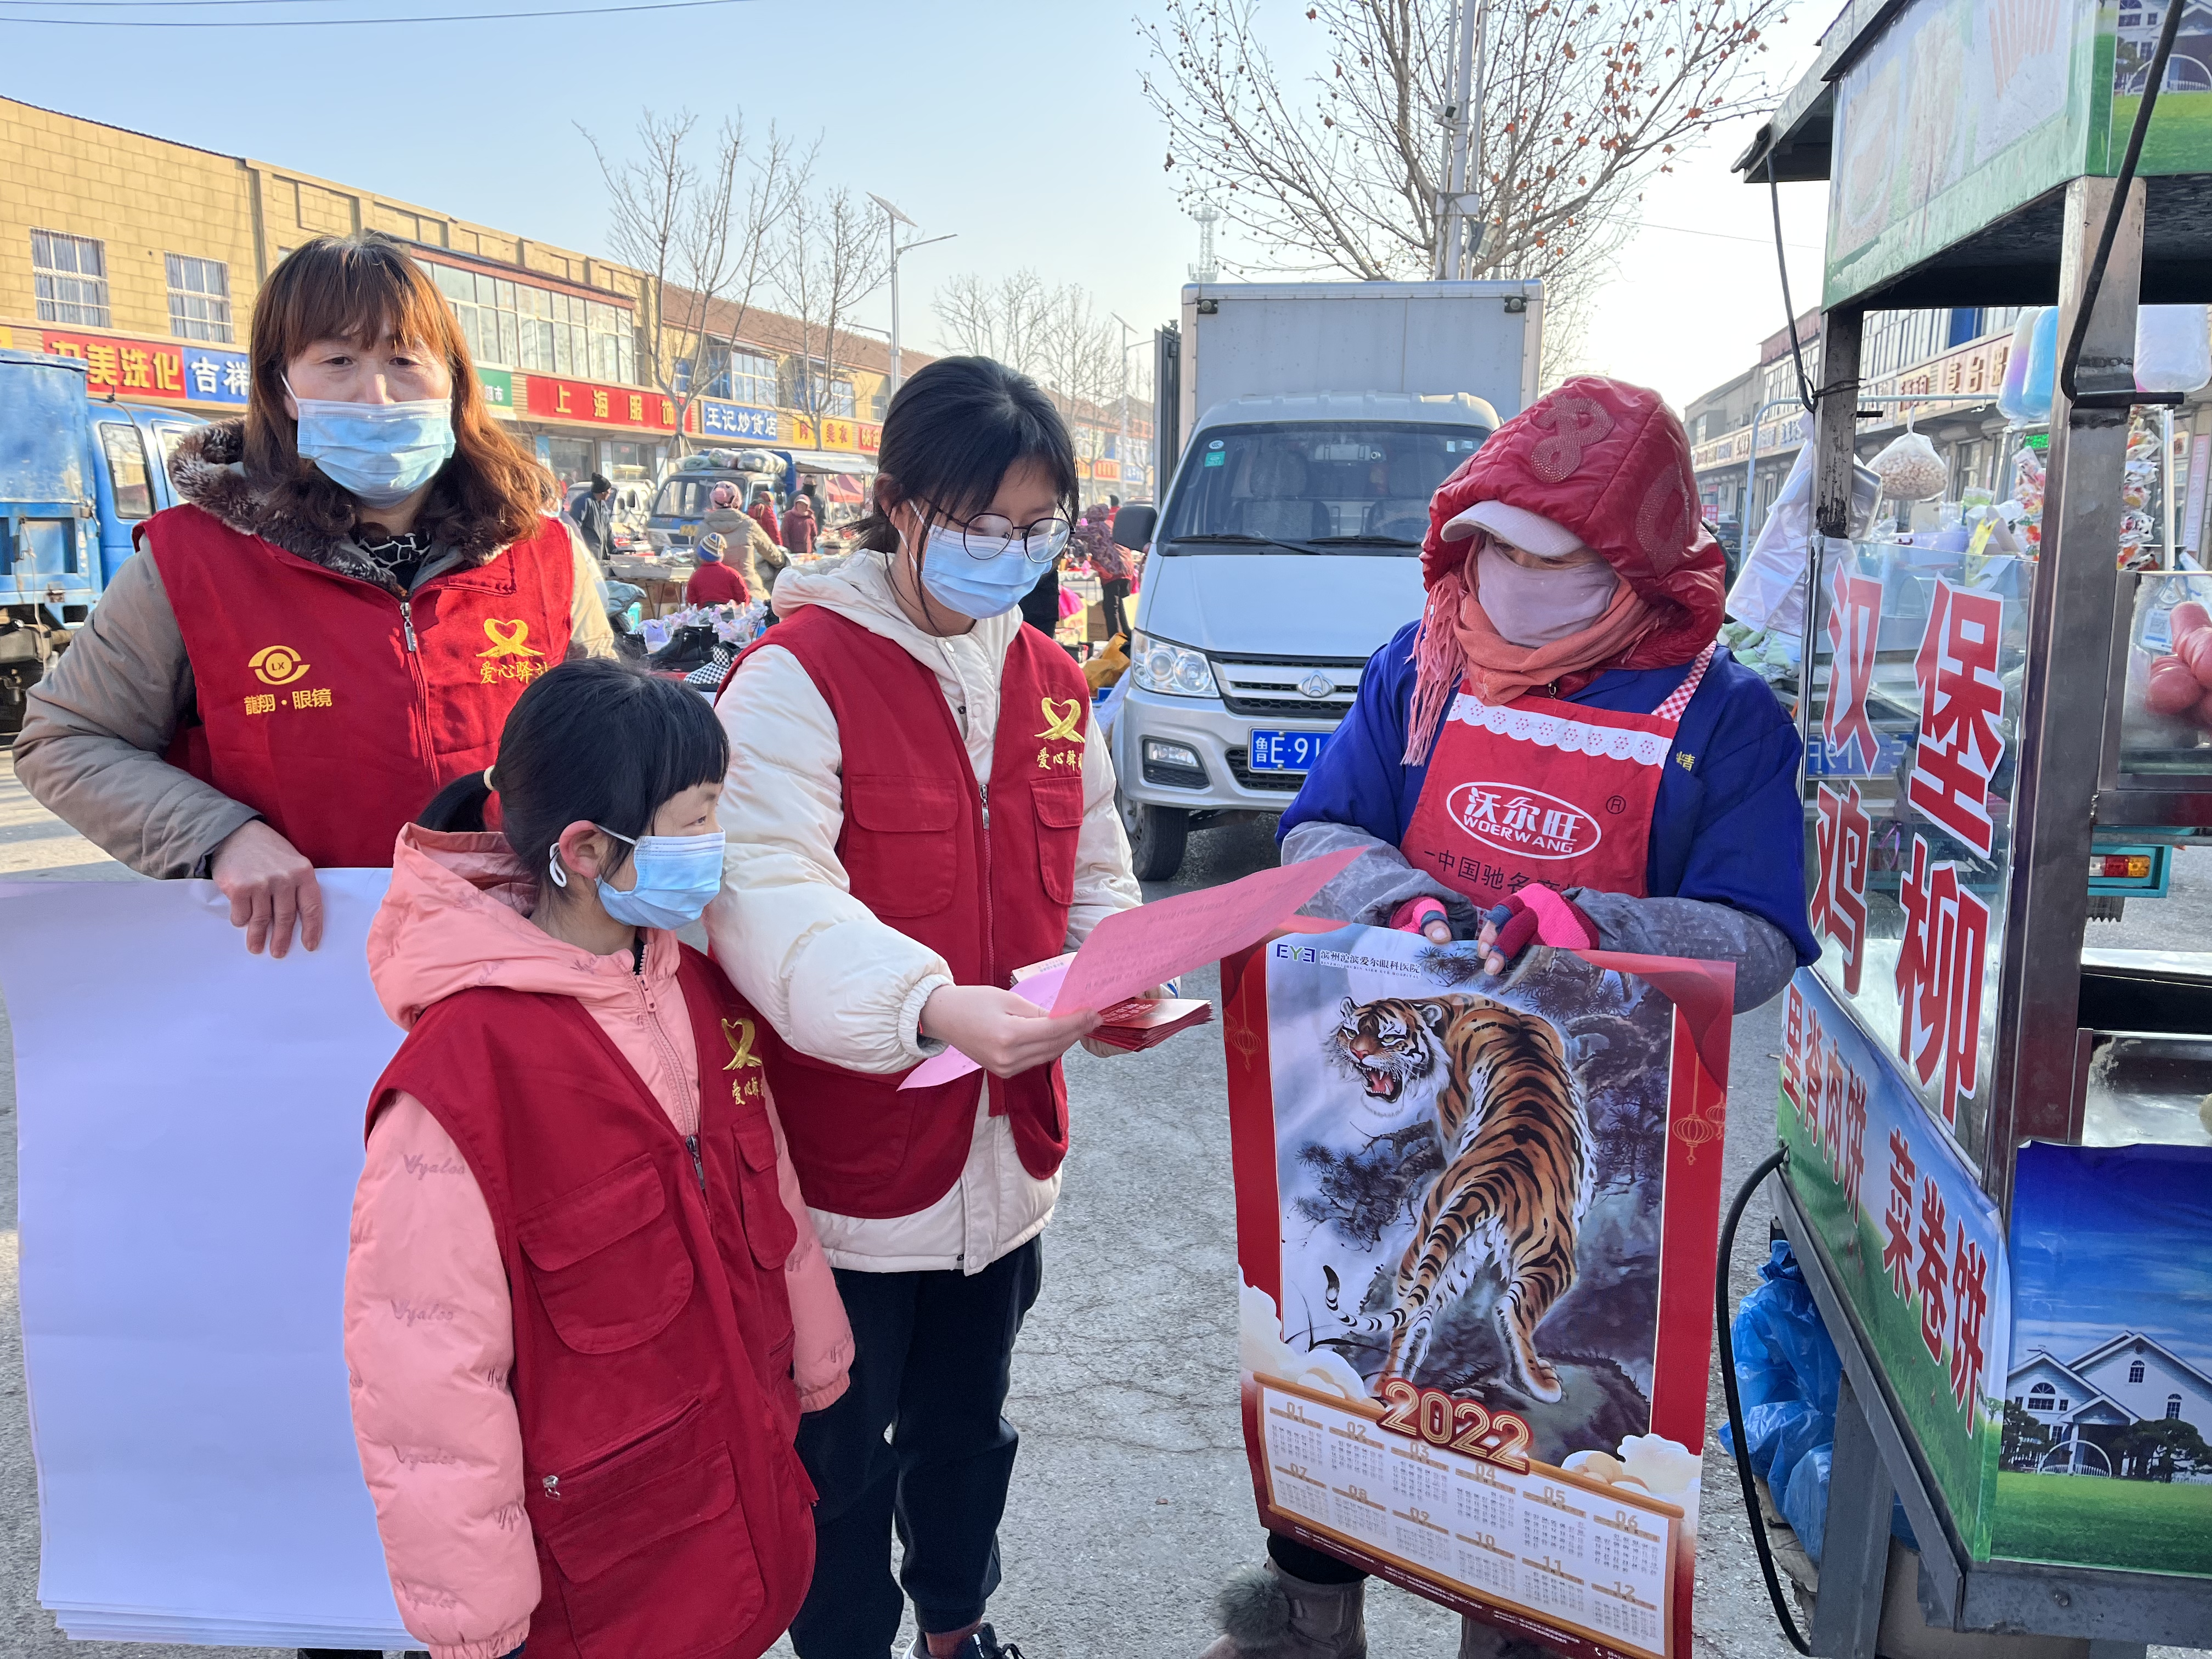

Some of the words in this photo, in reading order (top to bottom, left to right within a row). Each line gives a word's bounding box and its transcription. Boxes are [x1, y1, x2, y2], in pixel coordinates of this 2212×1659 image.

[706, 407, 777, 437] 王记炒货店
[271, 662, 285, 672] LX
[1463, 814, 1573, 854] WOERWANG
[1464, 787, 1584, 842] 沃尔旺
[1883, 1125, 1988, 1439] 菜卷饼
[1380, 1380, 1528, 1471] 2022
[1286, 1402, 1304, 1418] 01
[1347, 1421, 1367, 1437] 02
[1410, 1442, 1429, 1460] 03
[1475, 1463, 1496, 1480] 04
[1544, 1486, 1566, 1504] 05
[1615, 1510, 1638, 1530] 06
[1290, 1462, 1308, 1477] 07
[1410, 1506, 1430, 1521] 09
[1475, 1531, 1496, 1548] 10
[1543, 1555, 1562, 1573] 11
[1613, 1581, 1635, 1598] 12
